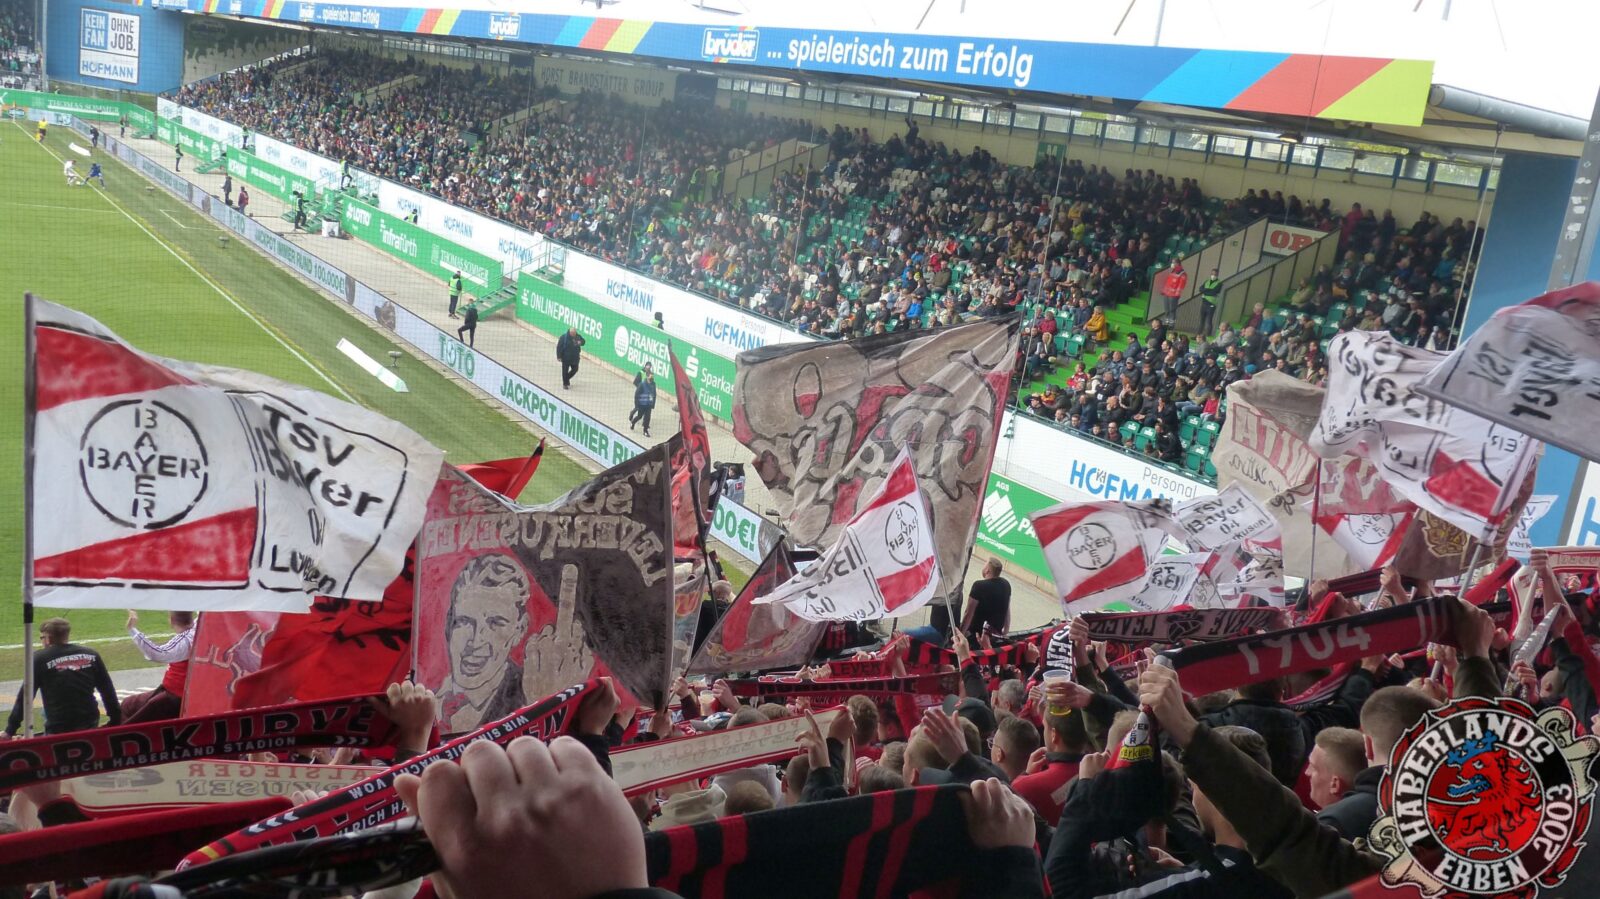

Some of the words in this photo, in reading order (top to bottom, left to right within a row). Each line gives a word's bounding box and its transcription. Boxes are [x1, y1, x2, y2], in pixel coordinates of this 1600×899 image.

[85, 13, 105, 30] KEIN
[110, 17, 135, 34] OHNE
[85, 30, 105, 47] FAN
[110, 33, 136, 52] JOB.
[82, 60, 134, 79] HOFMANN
[787, 34, 895, 68] spielerisch
[900, 46, 949, 73] zum
[955, 42, 1034, 88] Erfolg
[541, 67, 564, 83] HORST
[568, 69, 628, 91] BRANDSTÄTTER
[634, 77, 664, 96] GROUP
[443, 215, 473, 238] HOFMANN
[1269, 229, 1314, 251] OB
[381, 228, 418, 258] infrafürth
[498, 237, 533, 262] HOFMANN
[440, 249, 464, 270] THOMAS
[606, 278, 654, 312] HOFMANN
[530, 292, 603, 341] ONLINEPRINTERS
[629, 329, 671, 362] FRANKEN
[704, 316, 767, 354] HOFMANN
[439, 332, 476, 380] TOTO
[699, 389, 723, 412] Fürth
[500, 376, 558, 428] JACKPOT
[560, 410, 609, 460] IMMER
[262, 404, 355, 467] TSV
[88, 450, 202, 480] BAYER
[131, 407, 159, 519] BAYER
[1143, 466, 1198, 500] Personal
[1187, 498, 1248, 536] Bayer
[1193, 498, 1224, 515] TSV
[1219, 518, 1241, 535] 04
[1237, 626, 1371, 676] 1904
[502, 714, 530, 733] WIR
[37, 760, 106, 780] ULRICH
[112, 745, 215, 768] HABERLAND
[223, 736, 297, 754] STADION
